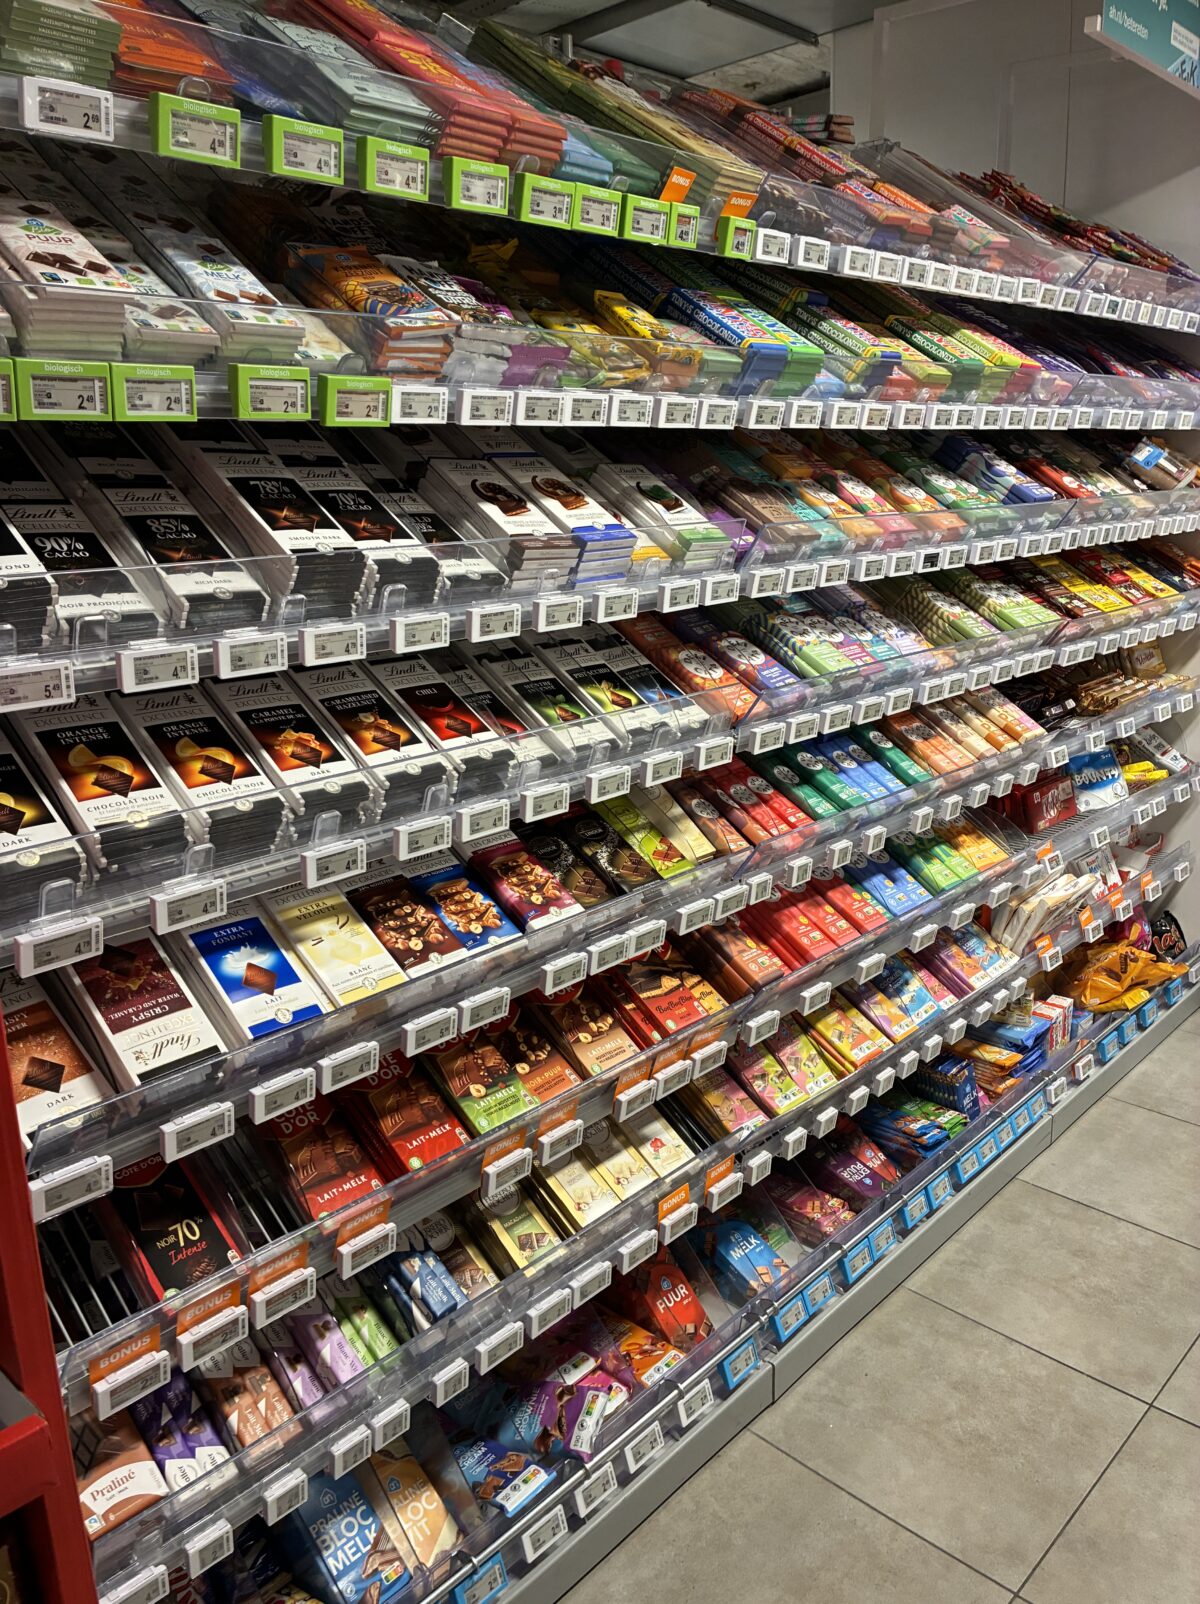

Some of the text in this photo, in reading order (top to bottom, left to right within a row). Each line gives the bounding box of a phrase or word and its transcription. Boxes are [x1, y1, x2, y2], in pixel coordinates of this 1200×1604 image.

[1108, 4, 1149, 40] ah.nl/beteraten
[183, 101, 217, 115] biologisch
[294, 122, 325, 136] biologisch
[385, 142, 412, 155] biologisch
[470, 162, 494, 173] biologisch
[671, 174, 690, 188] BONUS
[730, 196, 752, 206] BONUS
[25, 234, 74, 245] PUUR
[203, 271, 242, 281] MELK
[671, 292, 742, 347] TONY'S CHOCOLONELY
[795, 307, 865, 353] TONY'S CHOCOLONELY
[911, 332, 958, 364] CHOCOLONELY
[44, 364, 84, 375] biologisch
[136, 367, 171, 377] biologisch
[259, 368, 290, 378] biologisch
[218, 455, 261, 466] Lindt
[300, 469, 337, 480] Lindt
[249, 480, 291, 495] 78%
[115, 491, 163, 502] Lindt
[329, 492, 365, 505] 70%
[6, 507, 58, 519] Lindt
[146, 518, 189, 534] 85%
[156, 531, 197, 540] CACAO
[34, 536, 84, 553] 90%
[43, 550, 90, 559] CACAO
[58, 602, 85, 610] NOIR
[555, 648, 581, 659] Lindt
[309, 670, 346, 685] Lindt
[383, 663, 417, 677] Lindt
[574, 667, 611, 679] PISTACCHIO
[45, 683, 61, 698] 5.49
[228, 683, 269, 697] Lindt
[415, 687, 438, 697] CHILI
[135, 695, 180, 711] Lindt
[324, 692, 379, 708] CARAMELISED
[335, 699, 377, 711] HAZELNUT
[33, 713, 105, 727] EXCELLENCE
[142, 707, 205, 722] EXCELLENCE
[251, 707, 297, 719] CARAMEL
[263, 716, 286, 724] POINTE
[56, 727, 105, 739] ORANGE
[162, 721, 205, 733] ORANGE
[166, 725, 211, 739] INTENSE
[60, 732, 111, 745] INTENSE
[310, 769, 331, 777] DARK
[1075, 766, 1119, 786] BOUNTY
[196, 784, 241, 799] CHOCOLAT
[241, 780, 265, 790] NOIR
[86, 797, 139, 813] CHOCOLAT
[140, 793, 165, 802] NOIR
[1, 835, 33, 849] DARK
[470, 831, 513, 849] LES GRANDES
[407, 857, 455, 875] LES GRANDES
[345, 868, 394, 888] LES GRANDES
[274, 886, 332, 907] EXCELLENCE
[295, 903, 337, 922] VELOUTÉ
[297, 900, 329, 914] EXTRA
[211, 930, 254, 947] FONDANT
[213, 925, 245, 938] EXTRA
[348, 965, 373, 977] BLANC
[107, 992, 182, 1020] WAFER AND CARAMEL
[264, 995, 283, 1005] LAIT
[131, 1005, 170, 1023] CRISPY
[126, 1013, 195, 1041] EXCELLENCE
[150, 1031, 201, 1060] Lindt
[366, 1066, 404, 1087] D'OR
[622, 1066, 647, 1084] BONUS
[46, 1092, 75, 1109] DARK
[279, 1112, 320, 1135] D'OR
[489, 1133, 522, 1155] BONUS
[114, 1155, 163, 1181] CÔTE D'OR
[866, 1152, 887, 1169] PUUR
[710, 1160, 732, 1179] BONUS
[840, 1161, 864, 1179] PUUR
[848, 1166, 871, 1183] EXTRA
[662, 1190, 687, 1211] BONUS
[346, 1204, 386, 1230] BONUS
[156, 1234, 178, 1250] NOIR
[730, 1235, 761, 1261] MELK
[168, 1240, 208, 1267] Intense
[257, 1248, 301, 1276] BONUS
[184, 1289, 233, 1322] BONUS
[656, 1282, 690, 1315] PUUR
[98, 1335, 152, 1370] BONUS
[515, 1387, 540, 1440] BROWNIE
[90, 1469, 136, 1502] Praliné
[310, 1489, 364, 1538] PRALINÉ
[315, 1505, 374, 1556] BLOC
[321, 1523, 378, 1577] MELK
